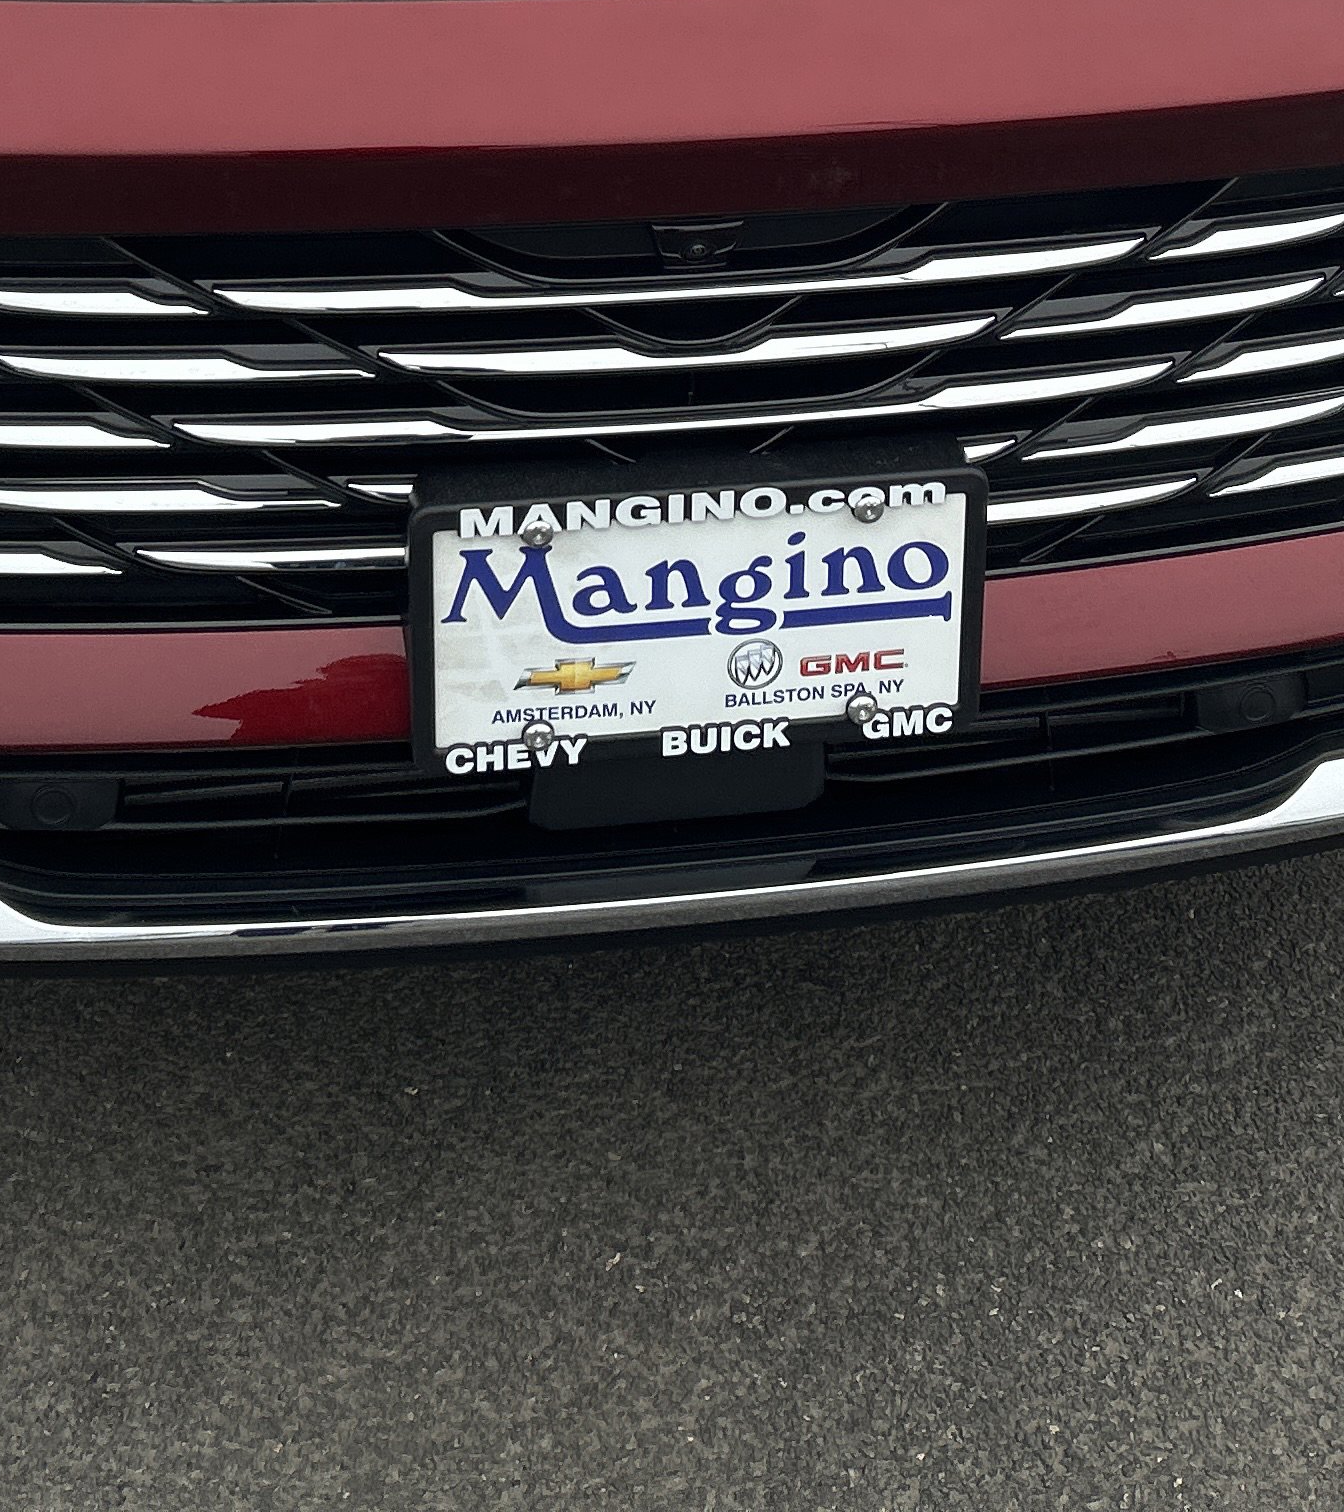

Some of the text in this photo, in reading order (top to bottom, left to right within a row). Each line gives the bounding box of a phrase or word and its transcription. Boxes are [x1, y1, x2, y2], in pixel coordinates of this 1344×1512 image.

[441, 531, 951, 644] Mangino
[799, 649, 905, 677] GMC
[725, 679, 905, 708] BALLSTON SPA, NY
[492, 699, 657, 725] AMSTERDAM, NY
[862, 706, 953, 739] GMC
[662, 720, 791, 757] BUICK
[445, 737, 588, 775] CHEVY
